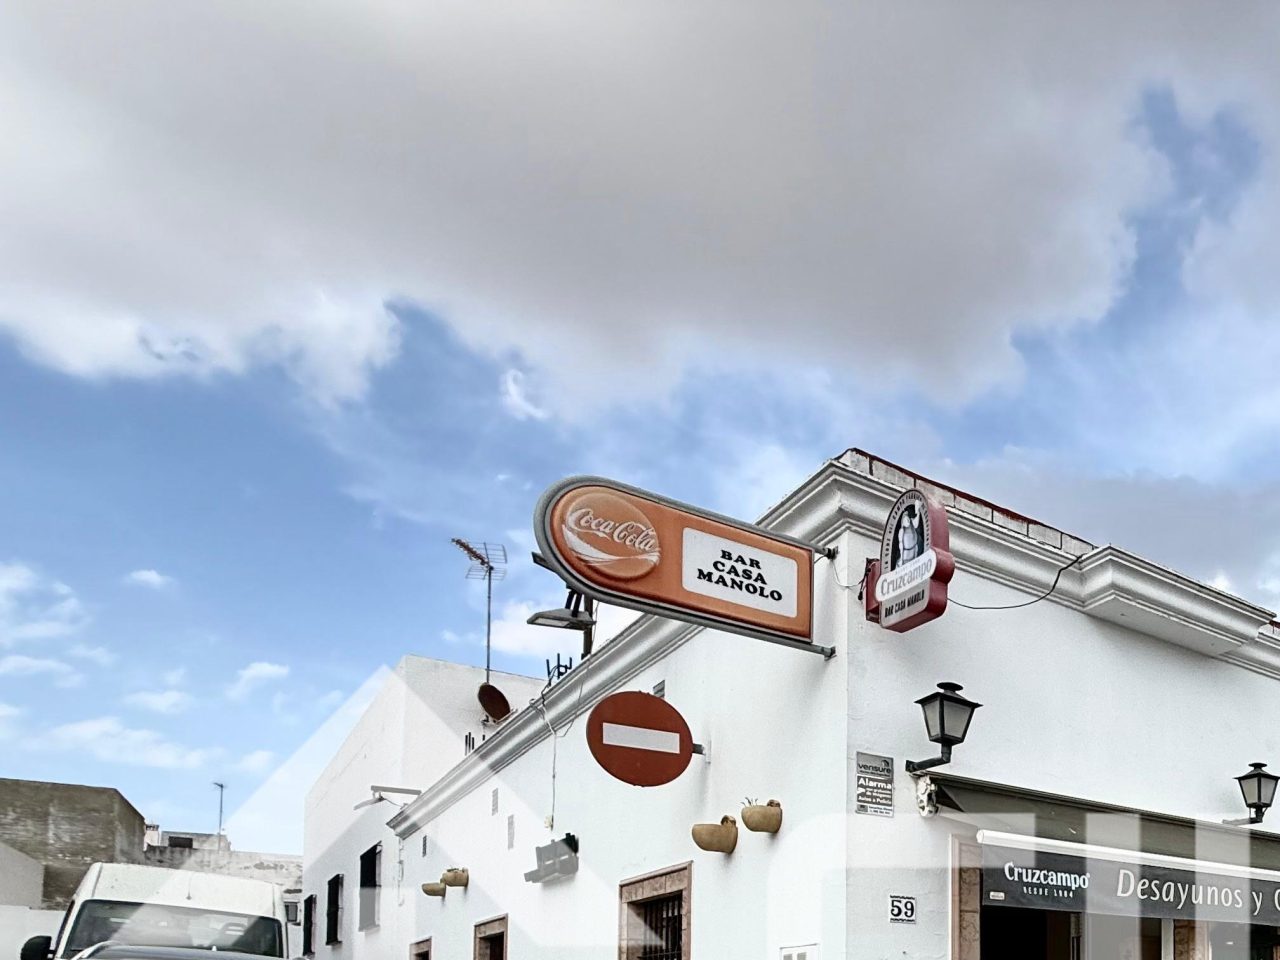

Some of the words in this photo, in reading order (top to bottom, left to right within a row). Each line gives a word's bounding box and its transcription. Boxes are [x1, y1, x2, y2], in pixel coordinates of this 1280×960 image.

[720, 549, 762, 570] BAR
[697, 568, 783, 601] MANOLO
[712, 560, 768, 586] CASA
[881, 558, 933, 596] Cruzcampo
[884, 604, 894, 618] BAR
[895, 598, 906, 613] CASA
[858, 777, 892, 790] Alarma
[1004, 861, 1090, 890] Cruzcampo
[1116, 869, 1243, 910] Desayunos
[1252, 891, 1264, 915] y
[891, 900, 914, 918] 59
